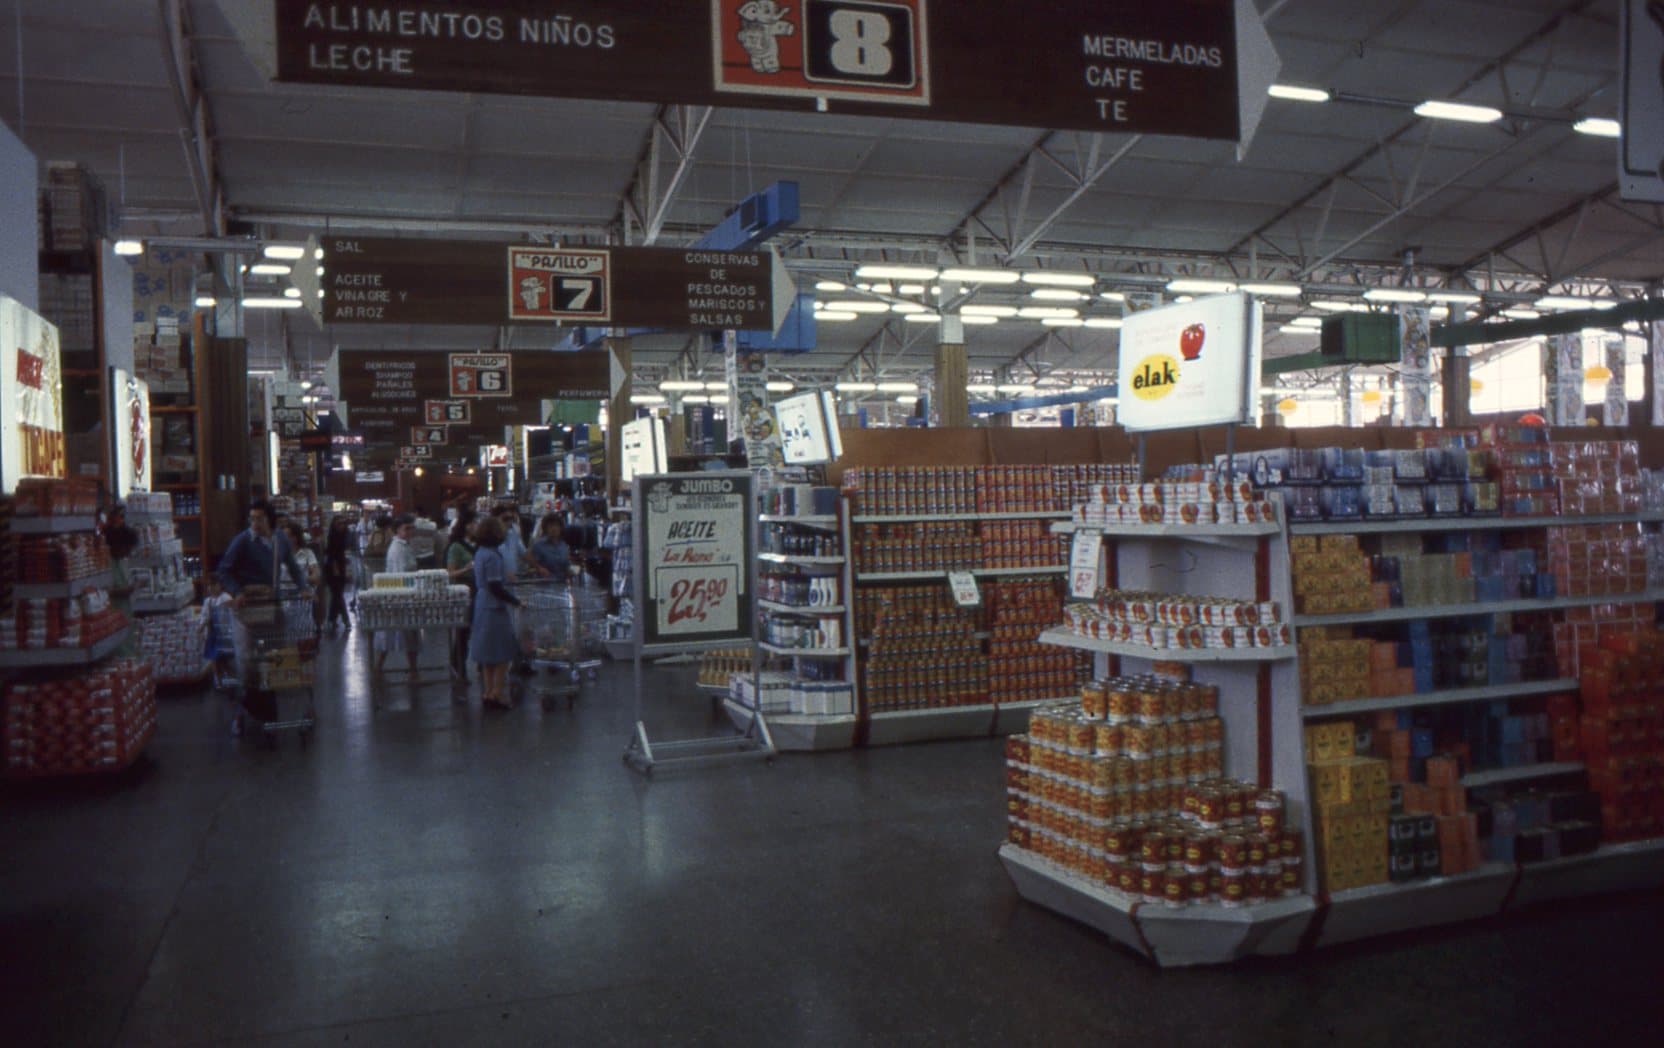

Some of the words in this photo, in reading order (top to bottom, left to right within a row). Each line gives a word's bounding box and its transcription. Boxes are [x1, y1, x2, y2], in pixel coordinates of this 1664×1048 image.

[305, 4, 504, 41] ALIMENTOS
[520, 14, 615, 49] NIÑOS
[829, 9, 894, 75] 8
[309, 43, 413, 73] LECHE
[1083, 35, 1222, 66] MERMELADAS
[1086, 65, 1143, 91] CAFE
[1096, 98, 1128, 121] TE
[335, 241, 363, 253] SAL
[685, 253, 759, 266] CONSERVAS
[335, 274, 382, 287] ACEITE
[709, 269, 726, 280] DE
[335, 290, 391, 302] VINAGRE
[399, 291, 407, 302] Y
[562, 280, 594, 309] 7
[687, 284, 756, 296] PESCADOS
[687, 298, 756, 311] MARISCOS
[758, 301, 766, 311] Y
[689, 313, 743, 325] SALSAS
[481, 371, 501, 390] 6
[1133, 361, 1177, 389] elak
[448, 405, 464, 420] 5
[428, 430, 442, 442] 4
[680, 479, 733, 493] JUMBO
[668, 520, 716, 540] ACEITE
